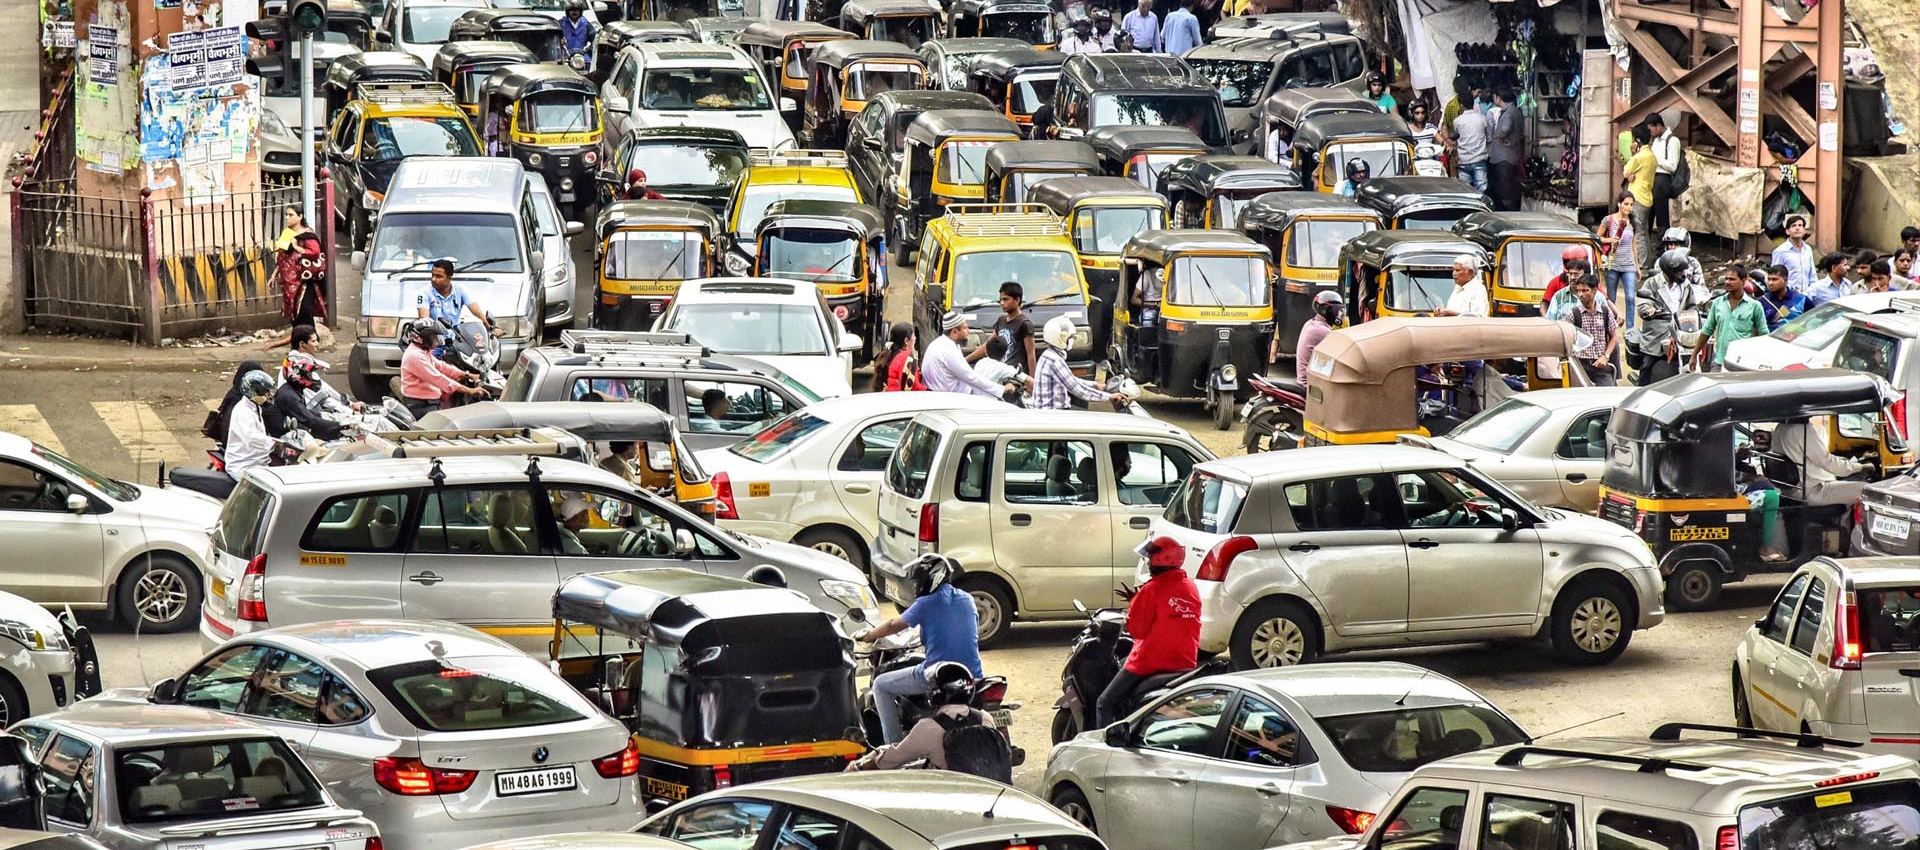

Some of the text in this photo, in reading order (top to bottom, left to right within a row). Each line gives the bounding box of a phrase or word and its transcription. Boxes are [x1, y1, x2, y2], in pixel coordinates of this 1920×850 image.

[501, 771, 572, 790] MH 48 AG 1999
